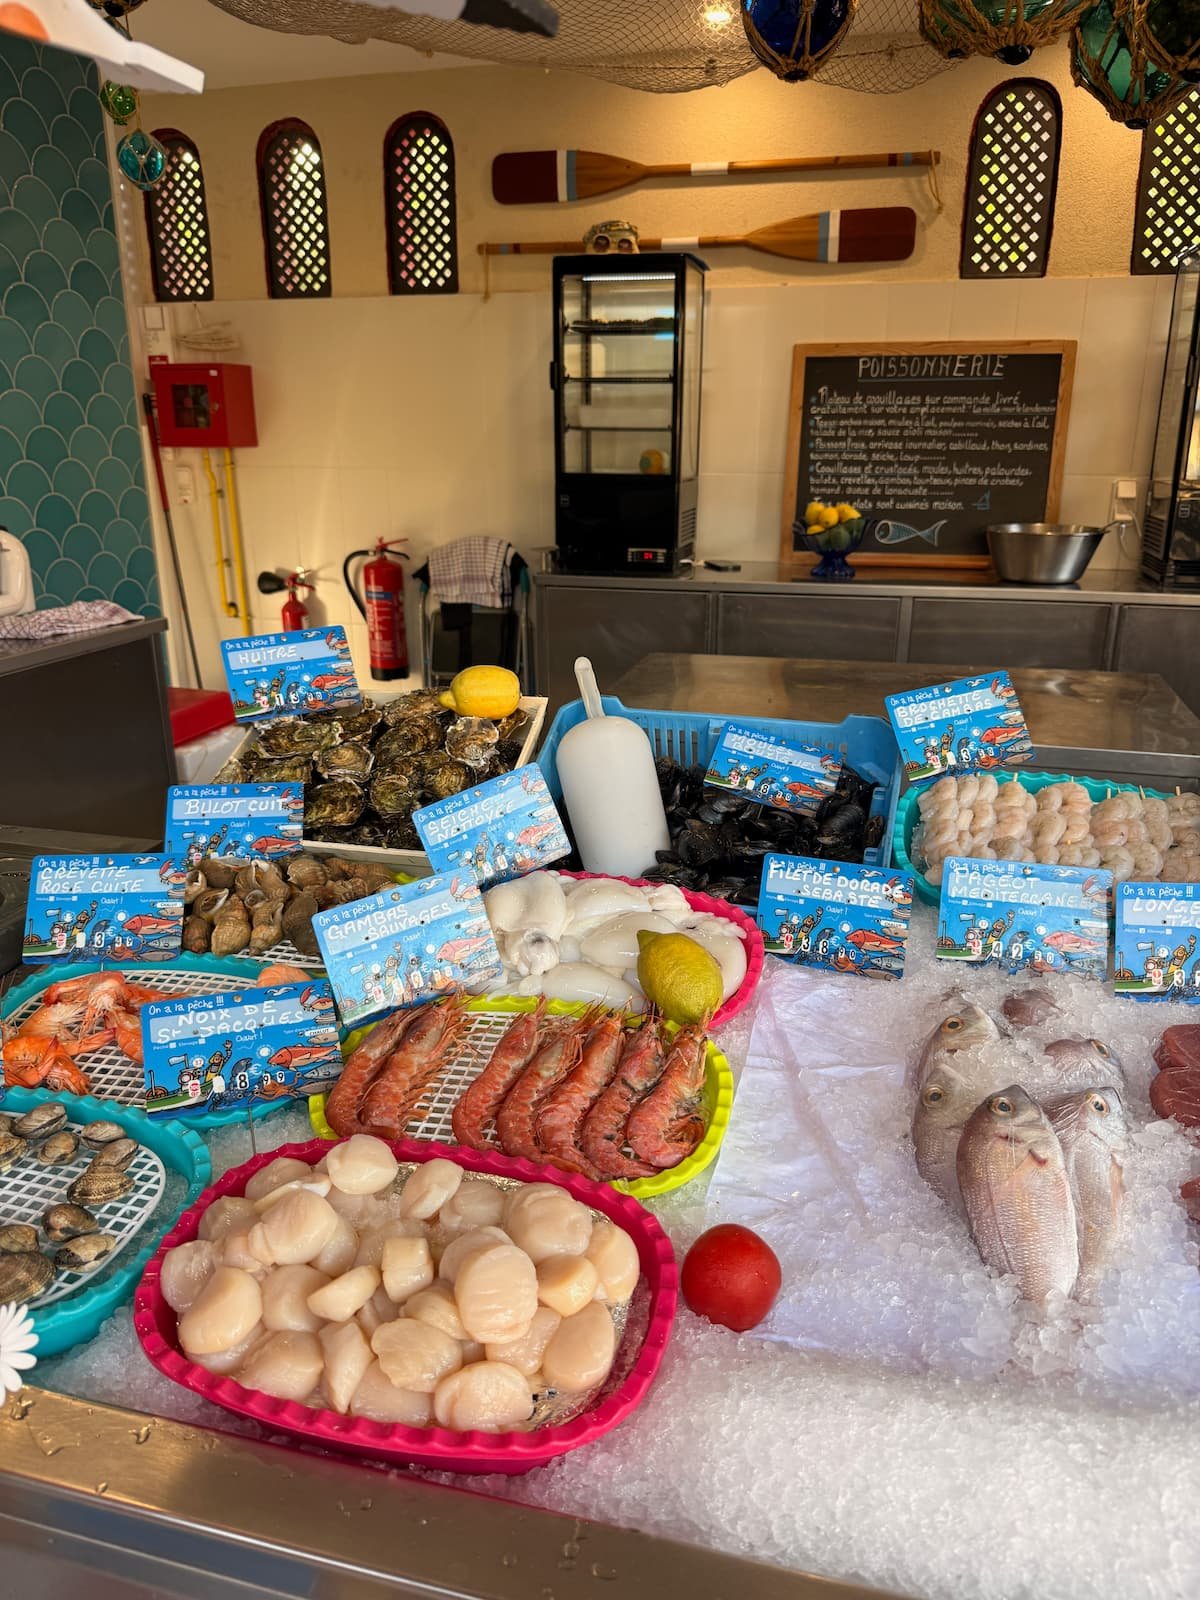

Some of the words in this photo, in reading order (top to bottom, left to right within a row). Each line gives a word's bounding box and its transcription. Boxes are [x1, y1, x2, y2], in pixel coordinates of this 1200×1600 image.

[858, 355, 1008, 378] POISSONNERIE
[853, 392, 864, 404] de
[995, 391, 1021, 405] livré
[875, 498, 894, 509] sont
[890, 697, 900, 706] On
[903, 715, 923, 727] DE
[173, 788, 182, 796] On
[184, 799, 246, 815] BULOT
[39, 858, 49, 868] On
[69, 857, 91, 870] pêche
[41, 866, 130, 880] CREVETTE
[768, 863, 812, 880] FILET
[813, 873, 833, 885] DE
[837, 876, 905, 898] DORADE
[954, 868, 1040, 889] PAGEOT
[40, 880, 83, 893] ROSE
[91, 878, 145, 893] CUITE
[1123, 885, 1134, 896] On
[1159, 886, 1183, 898] pêche
[800, 884, 883, 908] SEBASTE
[319, 916, 331, 927] On
[353, 904, 376, 918] pêche
[328, 905, 408, 940] GAMBAS
[366, 903, 452, 940] SAUVAGES
[148, 1004, 162, 1016] On
[187, 999, 214, 1012] pêche
[178, 1008, 231, 1027] NOIX
[243, 1000, 277, 1016] DE
[200, 1011, 304, 1038] JACQUES
